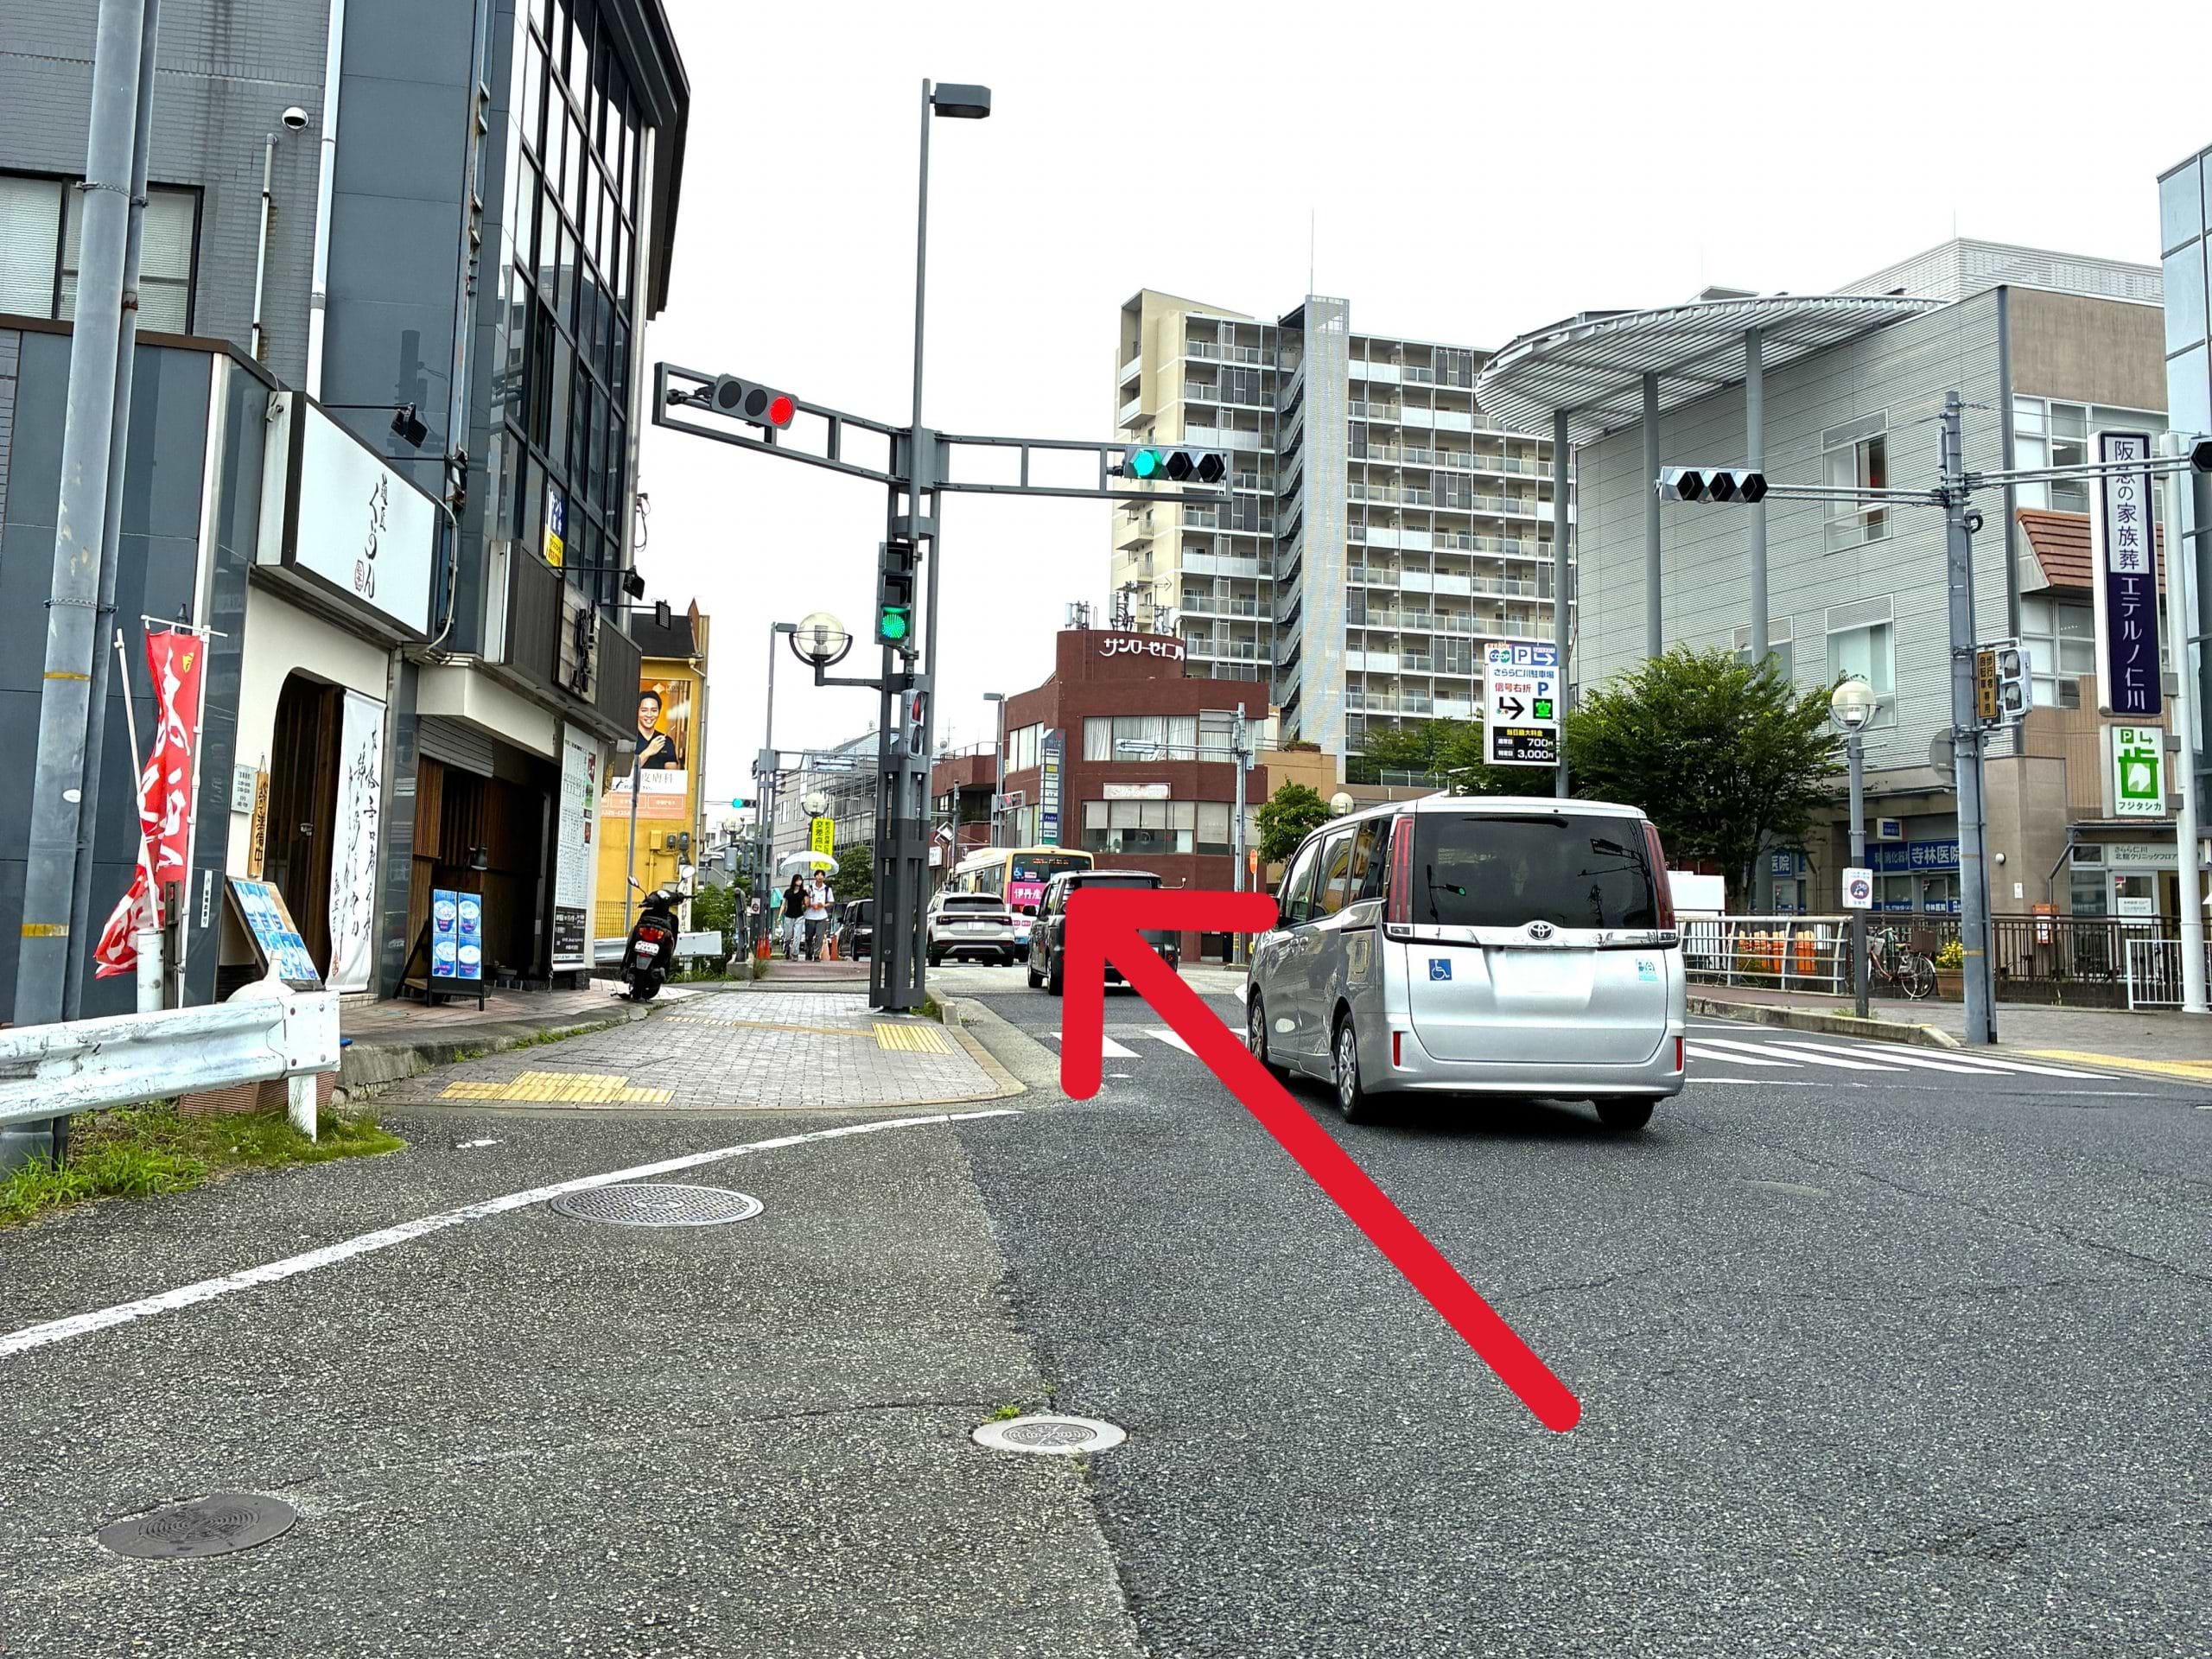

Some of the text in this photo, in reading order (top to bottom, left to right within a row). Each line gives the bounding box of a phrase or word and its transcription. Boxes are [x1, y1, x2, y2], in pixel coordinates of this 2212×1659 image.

[2121, 577, 2145, 710] エテルノ仁川
[1518, 649, 1528, 662] P
[1493, 669, 1554, 678] さらら仁川駐車場
[1495, 682, 1531, 693] 信号右折
[1537, 682, 1549, 696] P
[1535, 700, 1552, 717] 空
[2122, 731, 2133, 742] P
[2118, 801, 2162, 810] フジタシカ
[1911, 844, 1960, 865] 寺林医院
